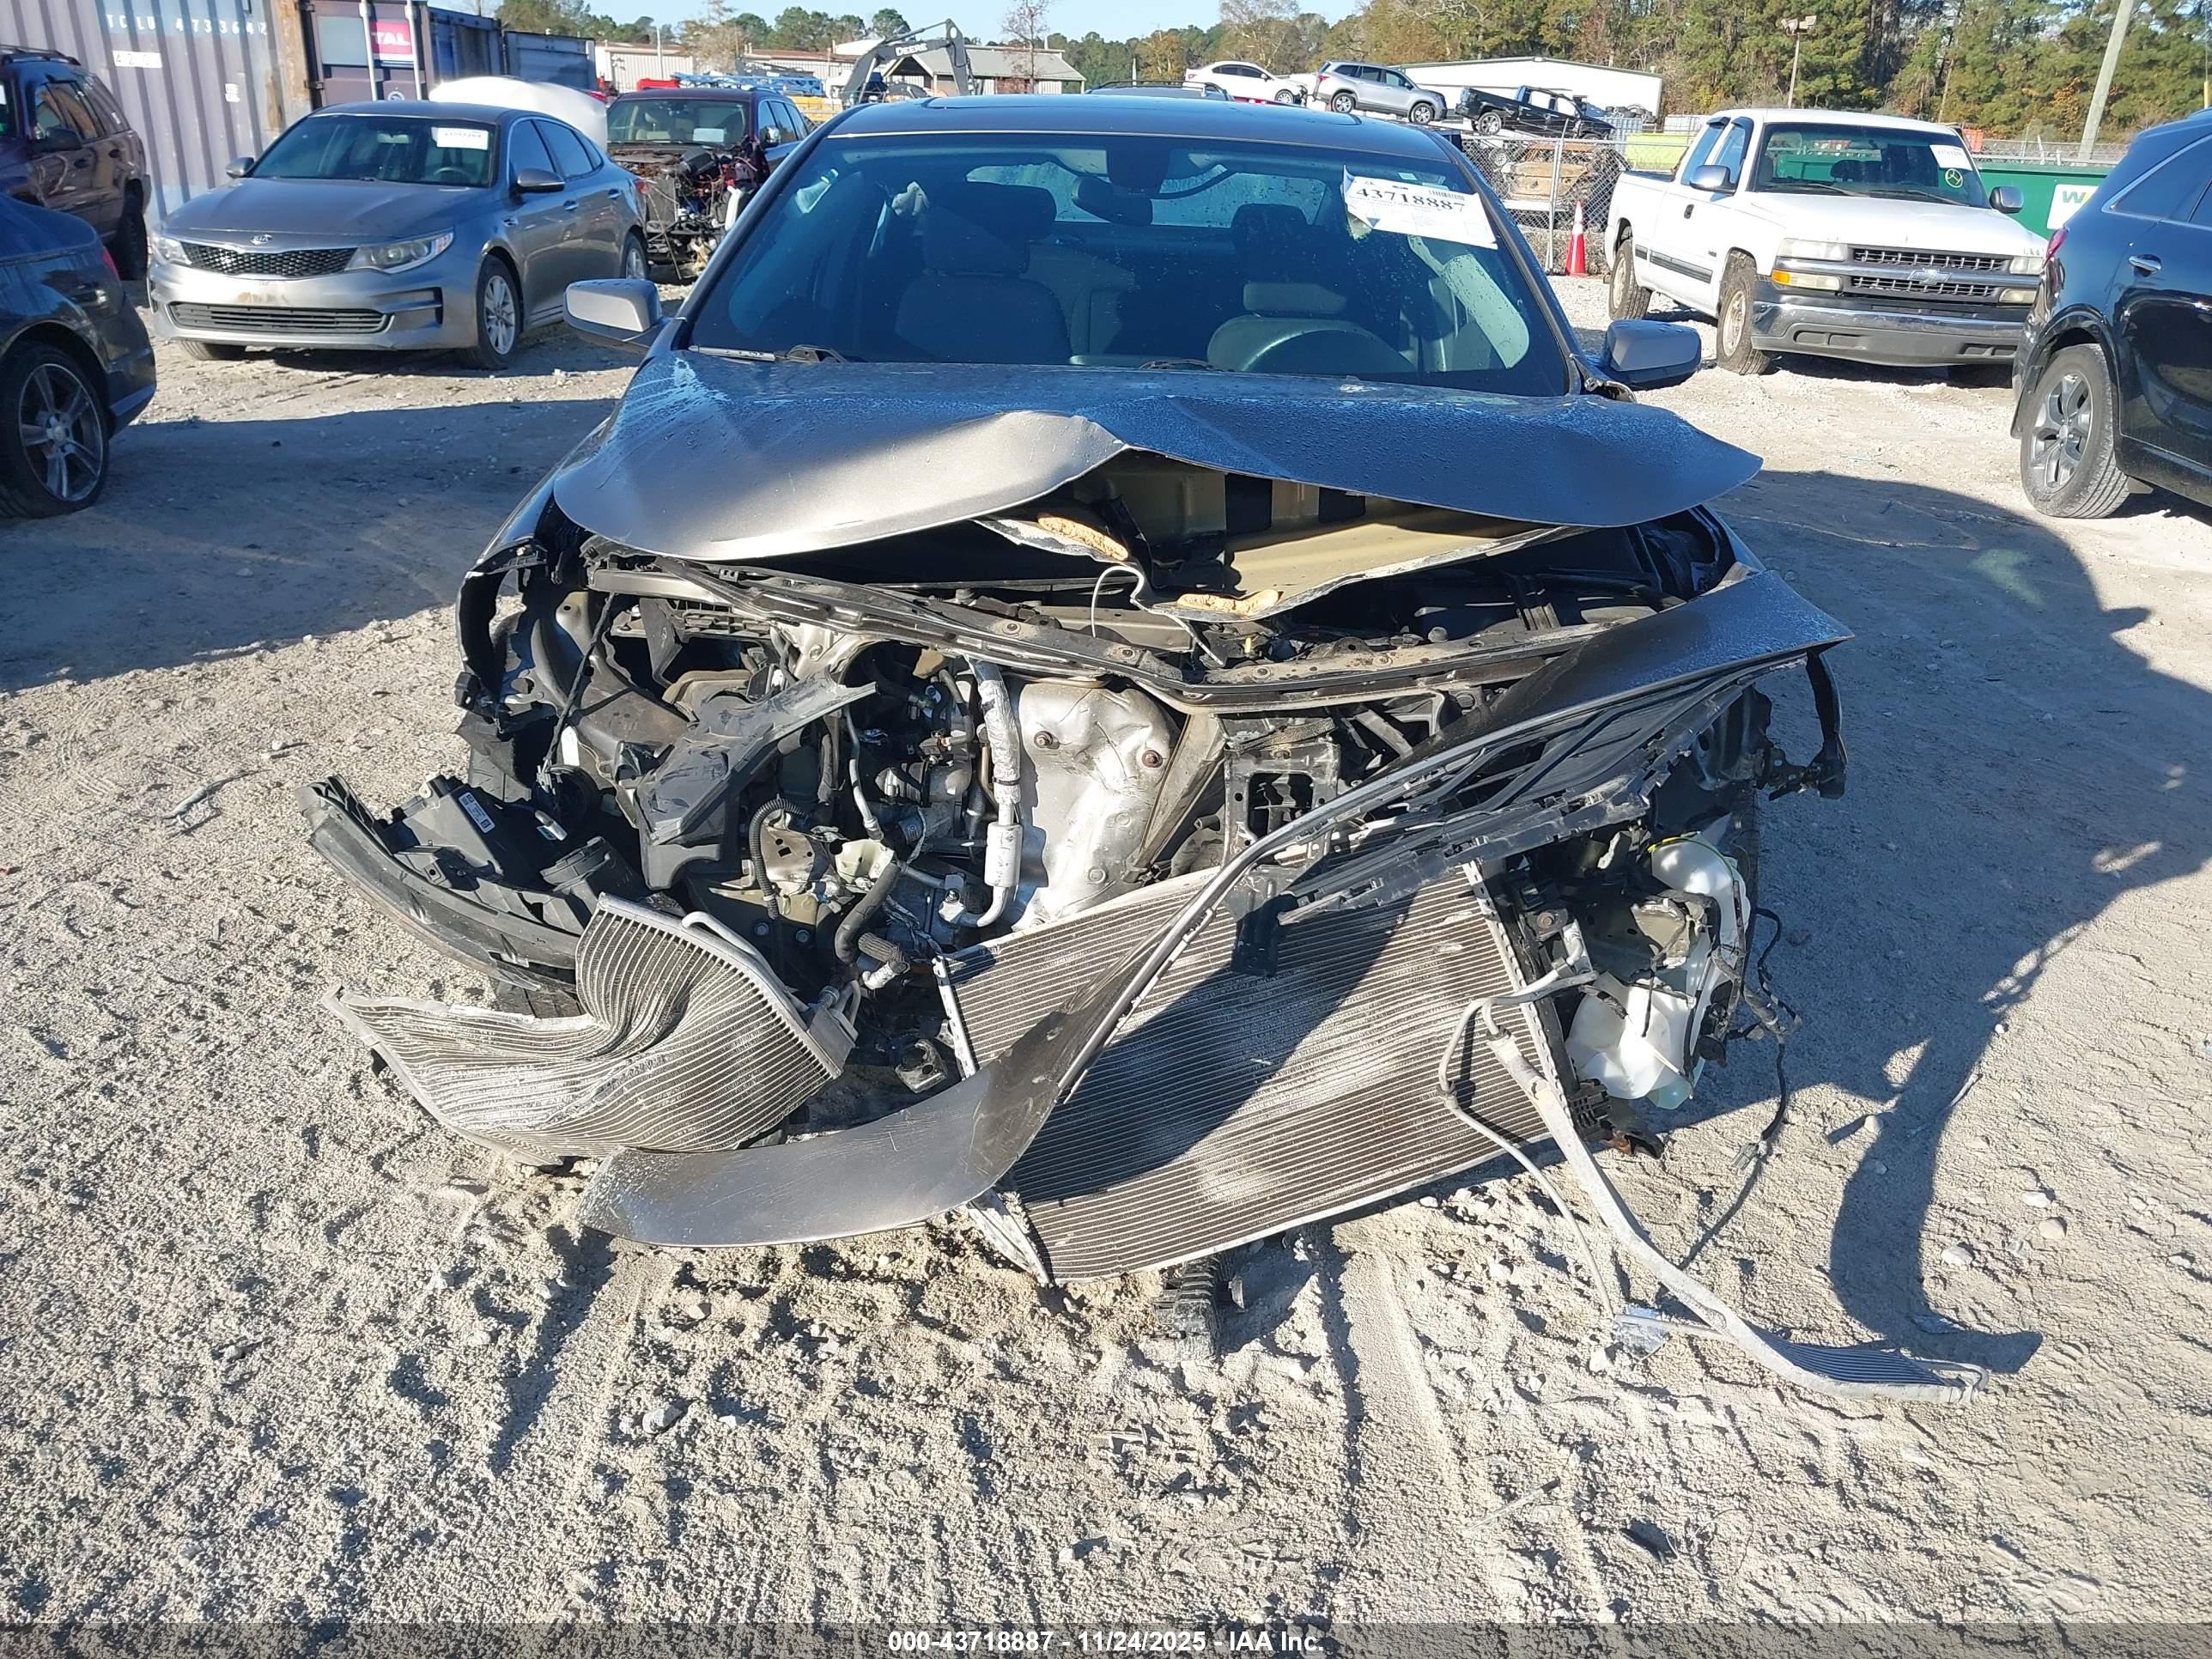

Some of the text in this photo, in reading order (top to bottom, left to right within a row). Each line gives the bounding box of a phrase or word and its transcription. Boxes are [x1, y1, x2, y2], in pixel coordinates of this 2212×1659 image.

[106, 14, 156, 30] TCLU
[895, 43, 927, 56] DEERE
[1356, 187, 1466, 212] 43718887
